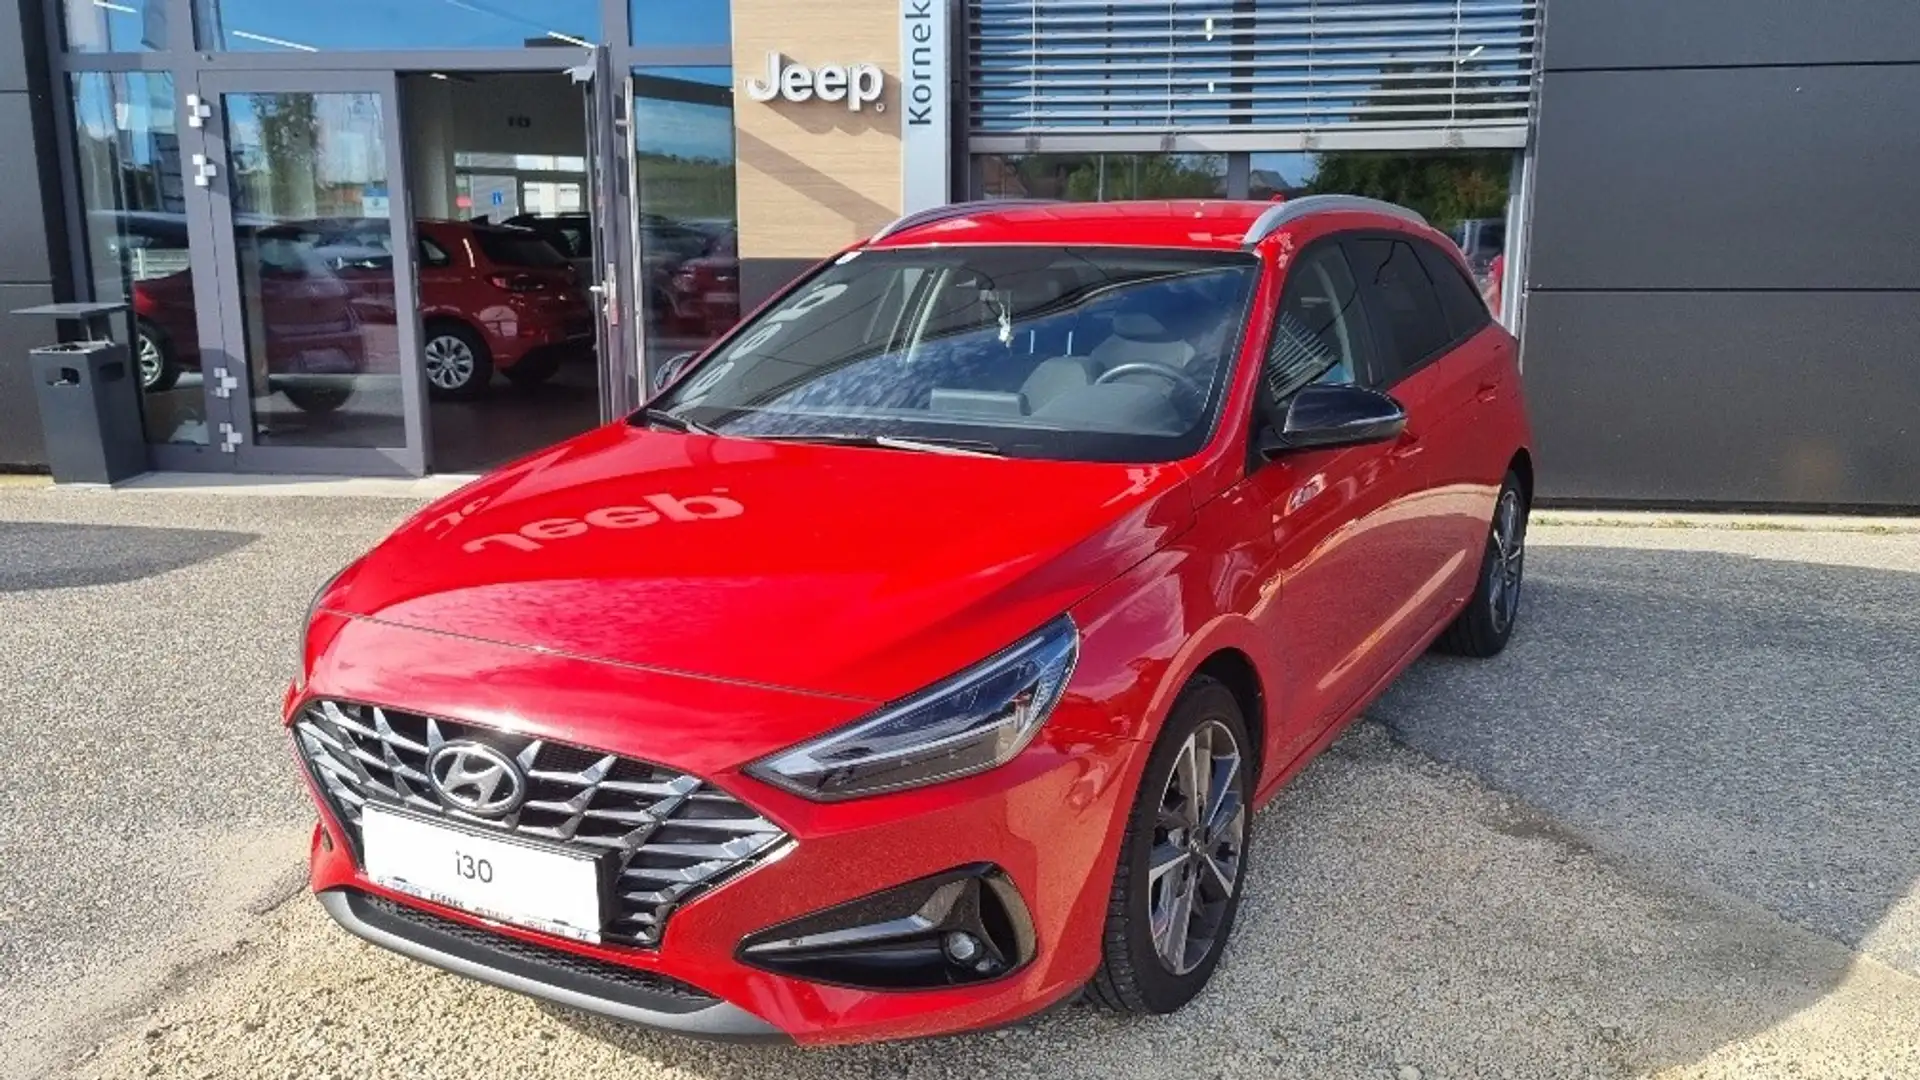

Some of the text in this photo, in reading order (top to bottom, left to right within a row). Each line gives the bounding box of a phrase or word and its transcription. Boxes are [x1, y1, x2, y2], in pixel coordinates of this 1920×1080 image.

[745, 51, 884, 111] Jeep
[905, 0, 932, 125] Kornek
[455, 850, 493, 883] i30
